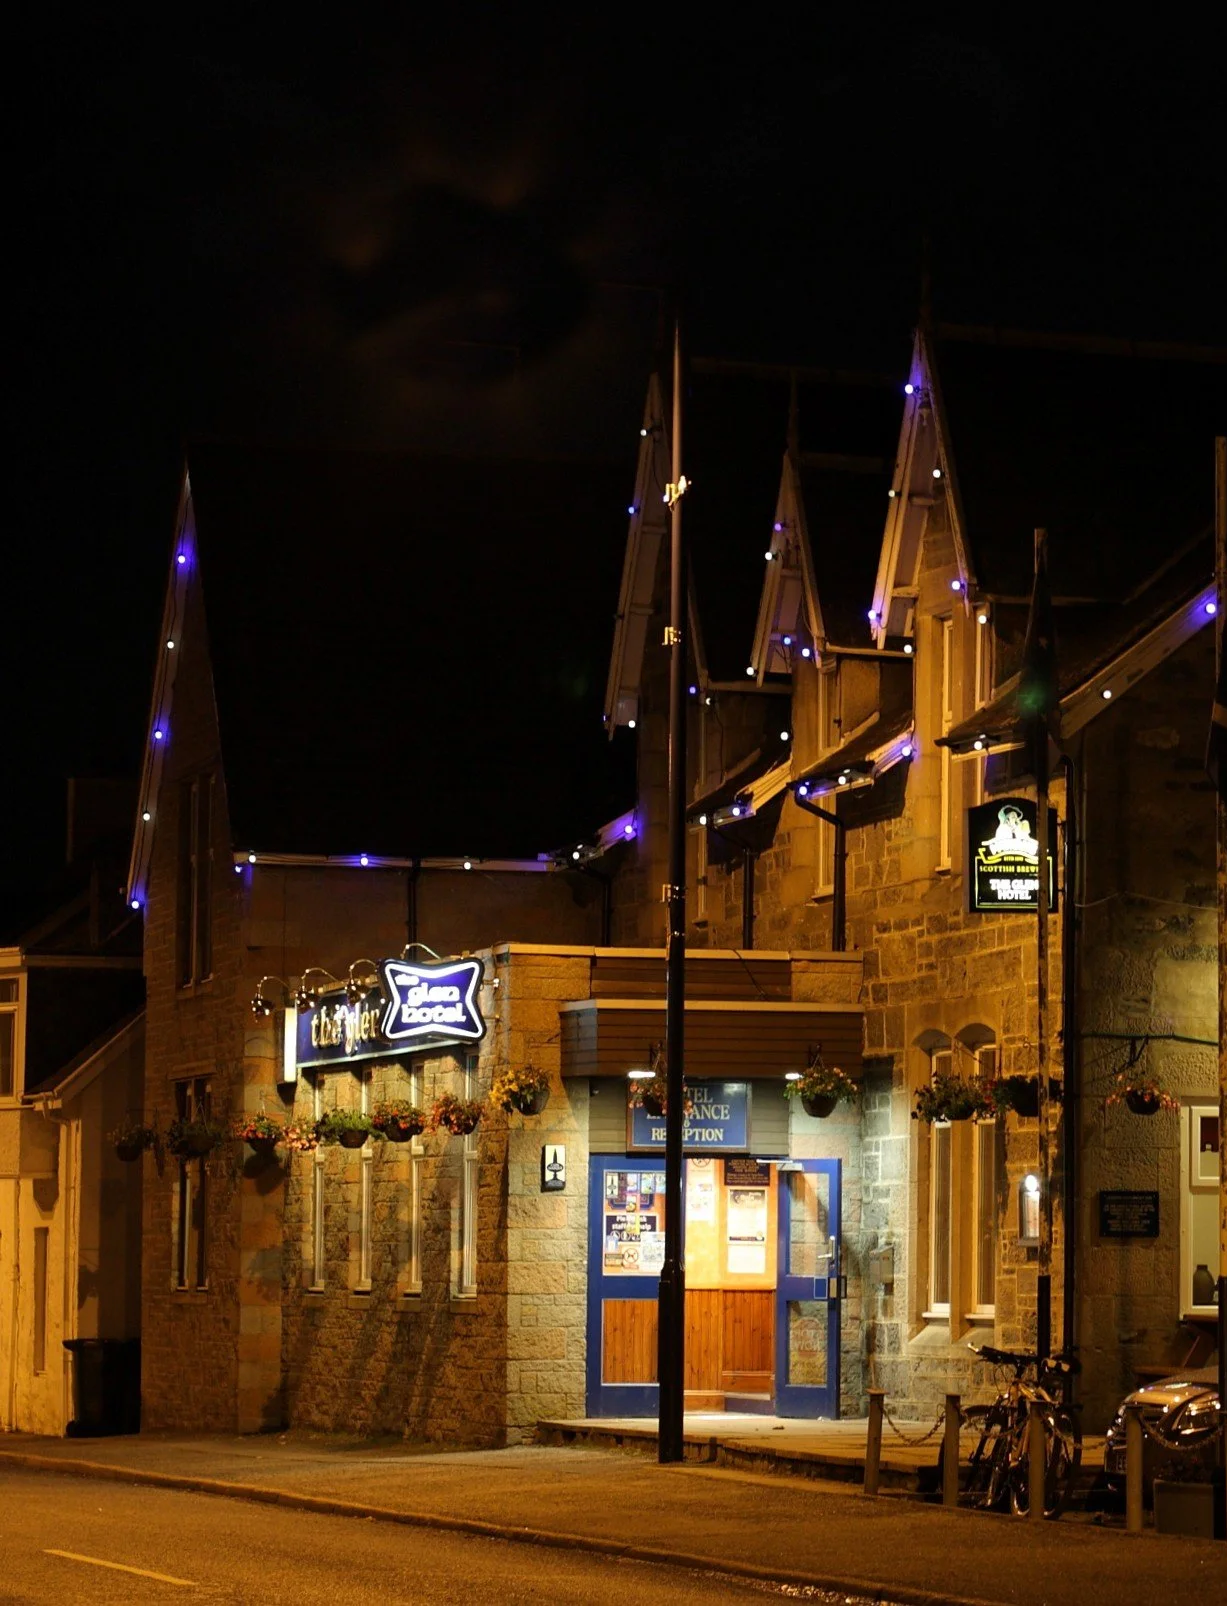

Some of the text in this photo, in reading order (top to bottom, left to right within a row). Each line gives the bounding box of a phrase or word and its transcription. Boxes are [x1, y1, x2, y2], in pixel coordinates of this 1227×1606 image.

[990, 879, 1039, 890] THE GLEN
[998, 889, 1031, 900] HOTEL
[407, 982, 460, 1007] glen
[401, 1002, 467, 1024] hotel
[686, 1087, 713, 1103] TEL
[651, 1128, 724, 1141] REPTION
